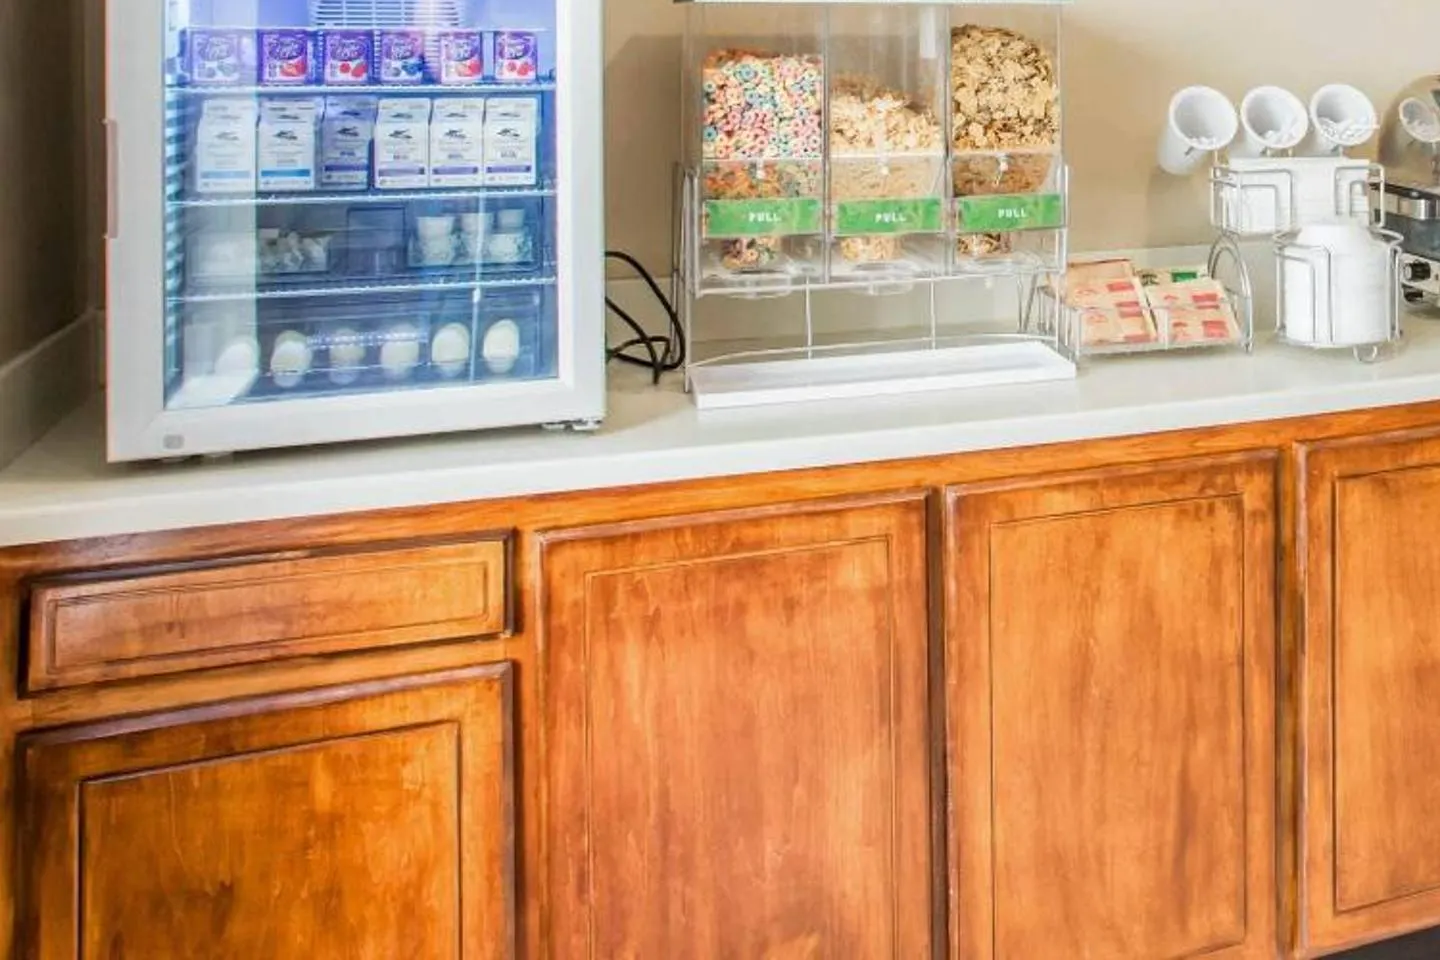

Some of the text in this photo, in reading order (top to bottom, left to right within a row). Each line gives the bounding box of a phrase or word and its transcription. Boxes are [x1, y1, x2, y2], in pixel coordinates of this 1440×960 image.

[748, 211, 782, 223] PULL
[875, 212, 907, 223] PULL
[998, 207, 1029, 219] PULL
